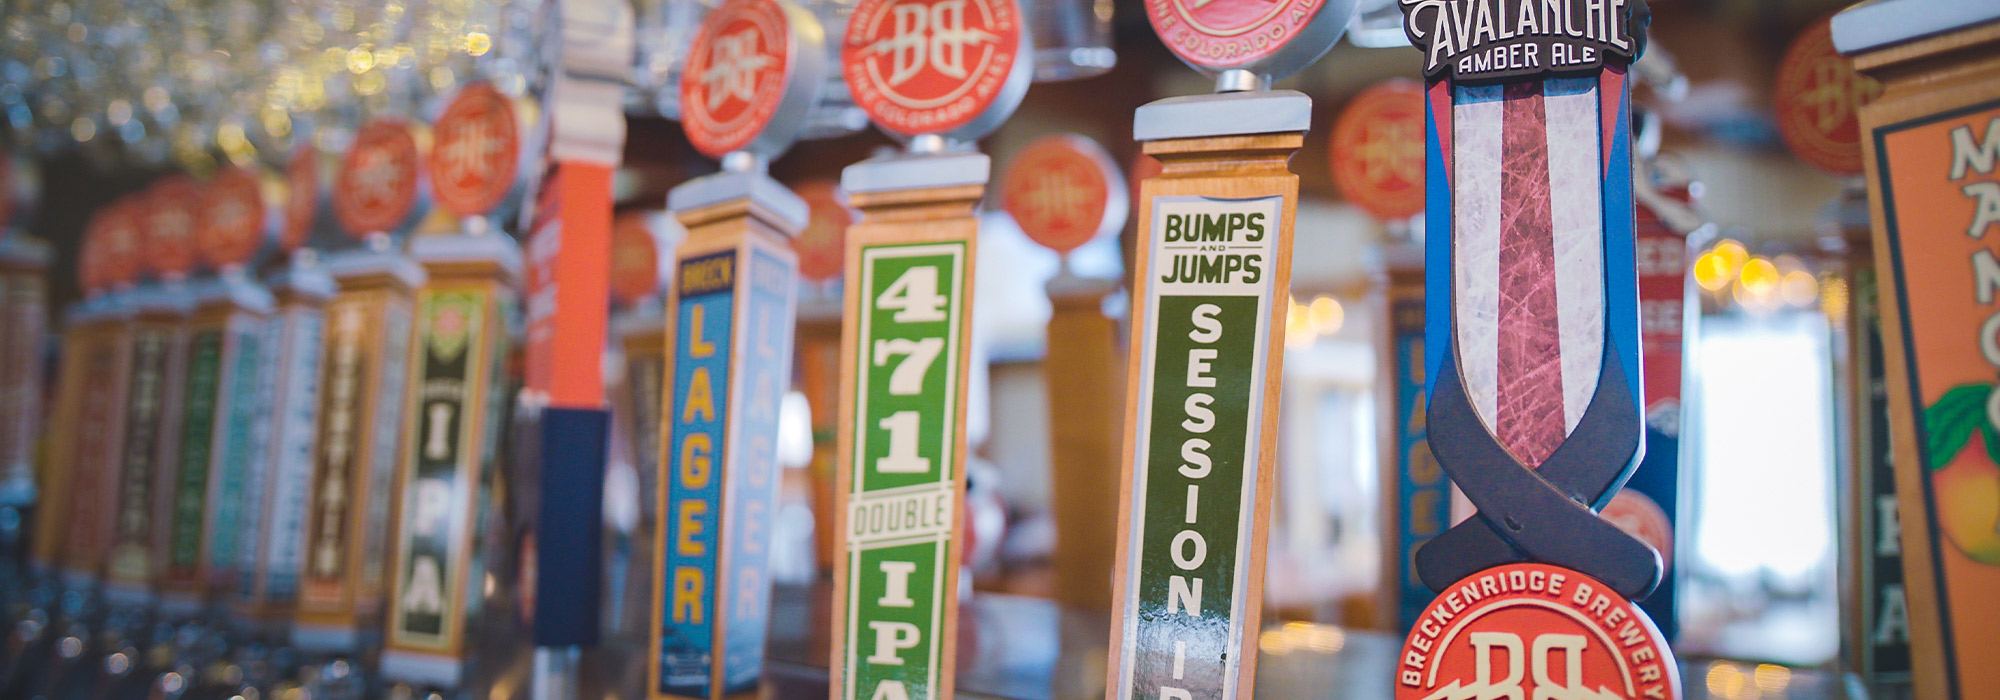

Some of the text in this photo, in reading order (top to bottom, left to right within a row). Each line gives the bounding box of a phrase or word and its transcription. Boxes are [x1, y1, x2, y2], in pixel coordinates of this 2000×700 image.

[1174, 23, 1286, 60] COLORADO
[1408, 0, 1629, 71] AVALANCHE
[1458, 42, 1596, 74] AMBER ALE
[1164, 212, 1265, 242] BUMPS
[1199, 244, 1226, 252] AND
[1161, 254, 1262, 284] JUMPS
[873, 265, 949, 474] 471
[672, 302, 717, 625] LAGER
[1166, 302, 1224, 617] SESSION
[853, 493, 948, 536] DOUBLE
[1401, 569, 1666, 700] BRECKENRIDGE BREWERY
